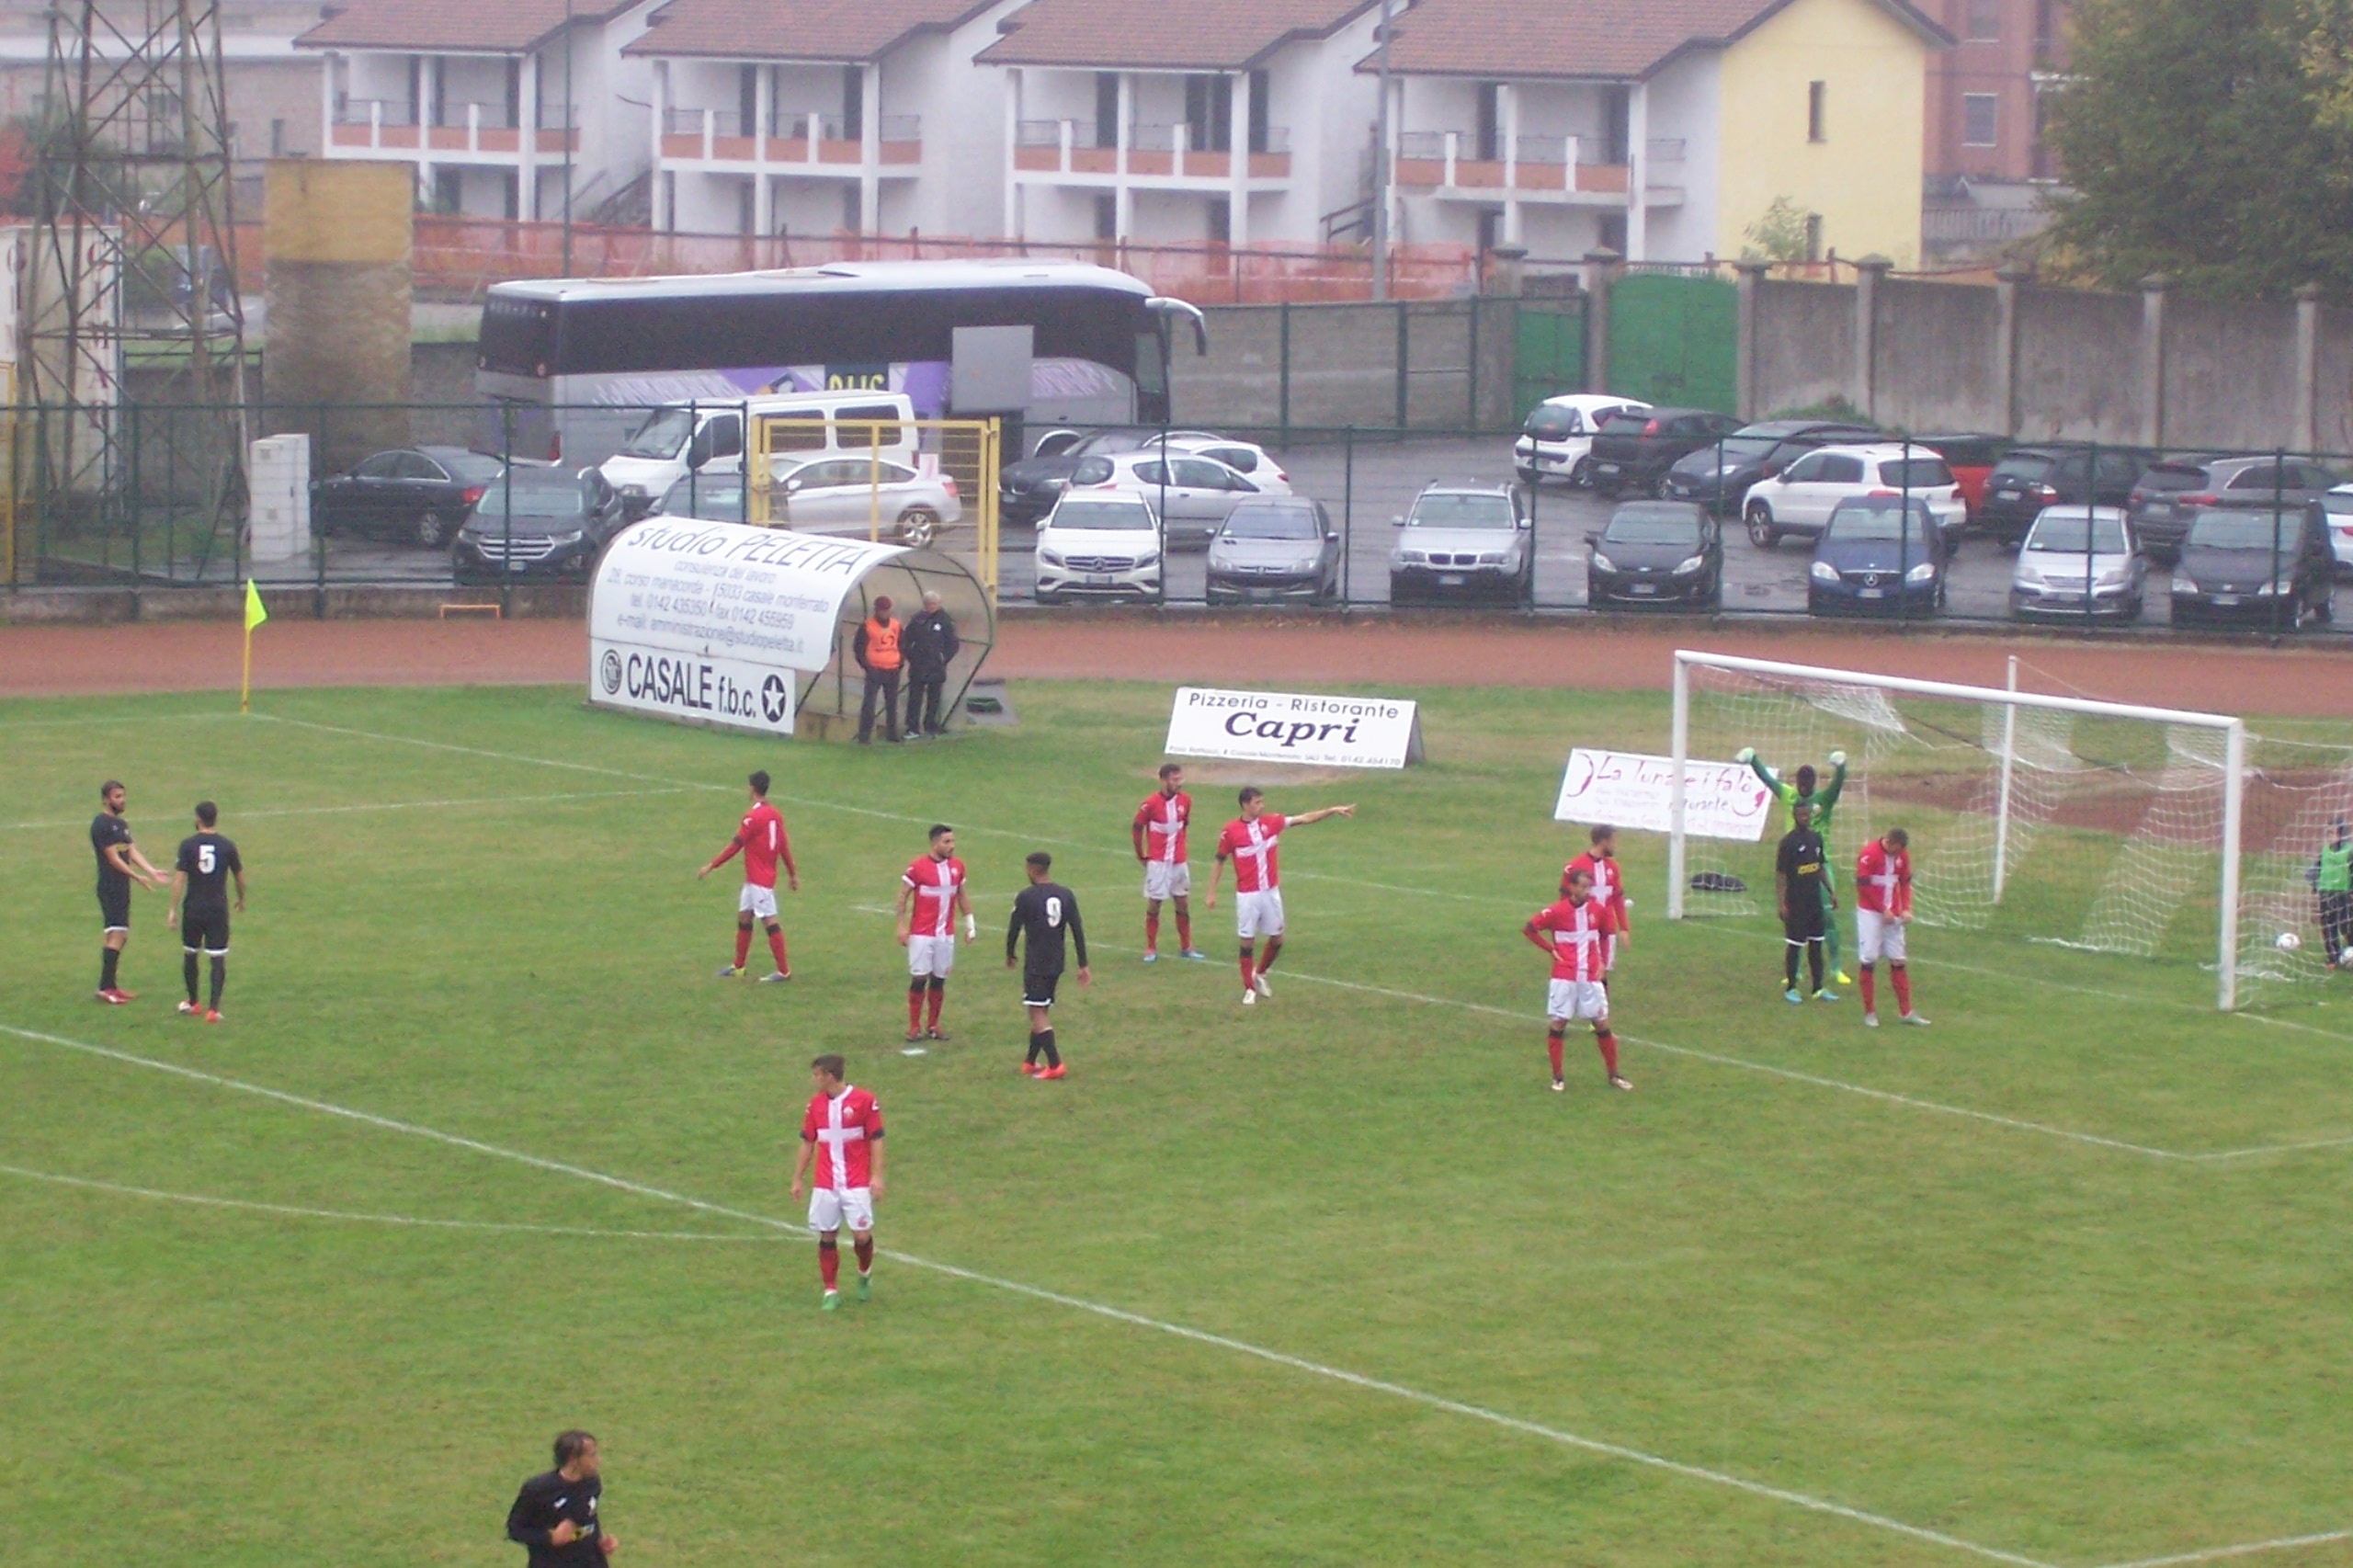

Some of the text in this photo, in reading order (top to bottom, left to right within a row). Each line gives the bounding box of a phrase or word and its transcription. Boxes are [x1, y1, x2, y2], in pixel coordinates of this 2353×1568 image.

[628, 527, 872, 575] studio PELETTA
[627, 653, 757, 719] CASALE f.b.c.
[1188, 692, 1268, 709] Pizzeria
[1290, 698, 1400, 719] Ristorante
[1224, 711, 1360, 747] Capri
[1597, 756, 1622, 781] La
[198, 845, 216, 874] 5
[1045, 896, 1063, 928] 9
